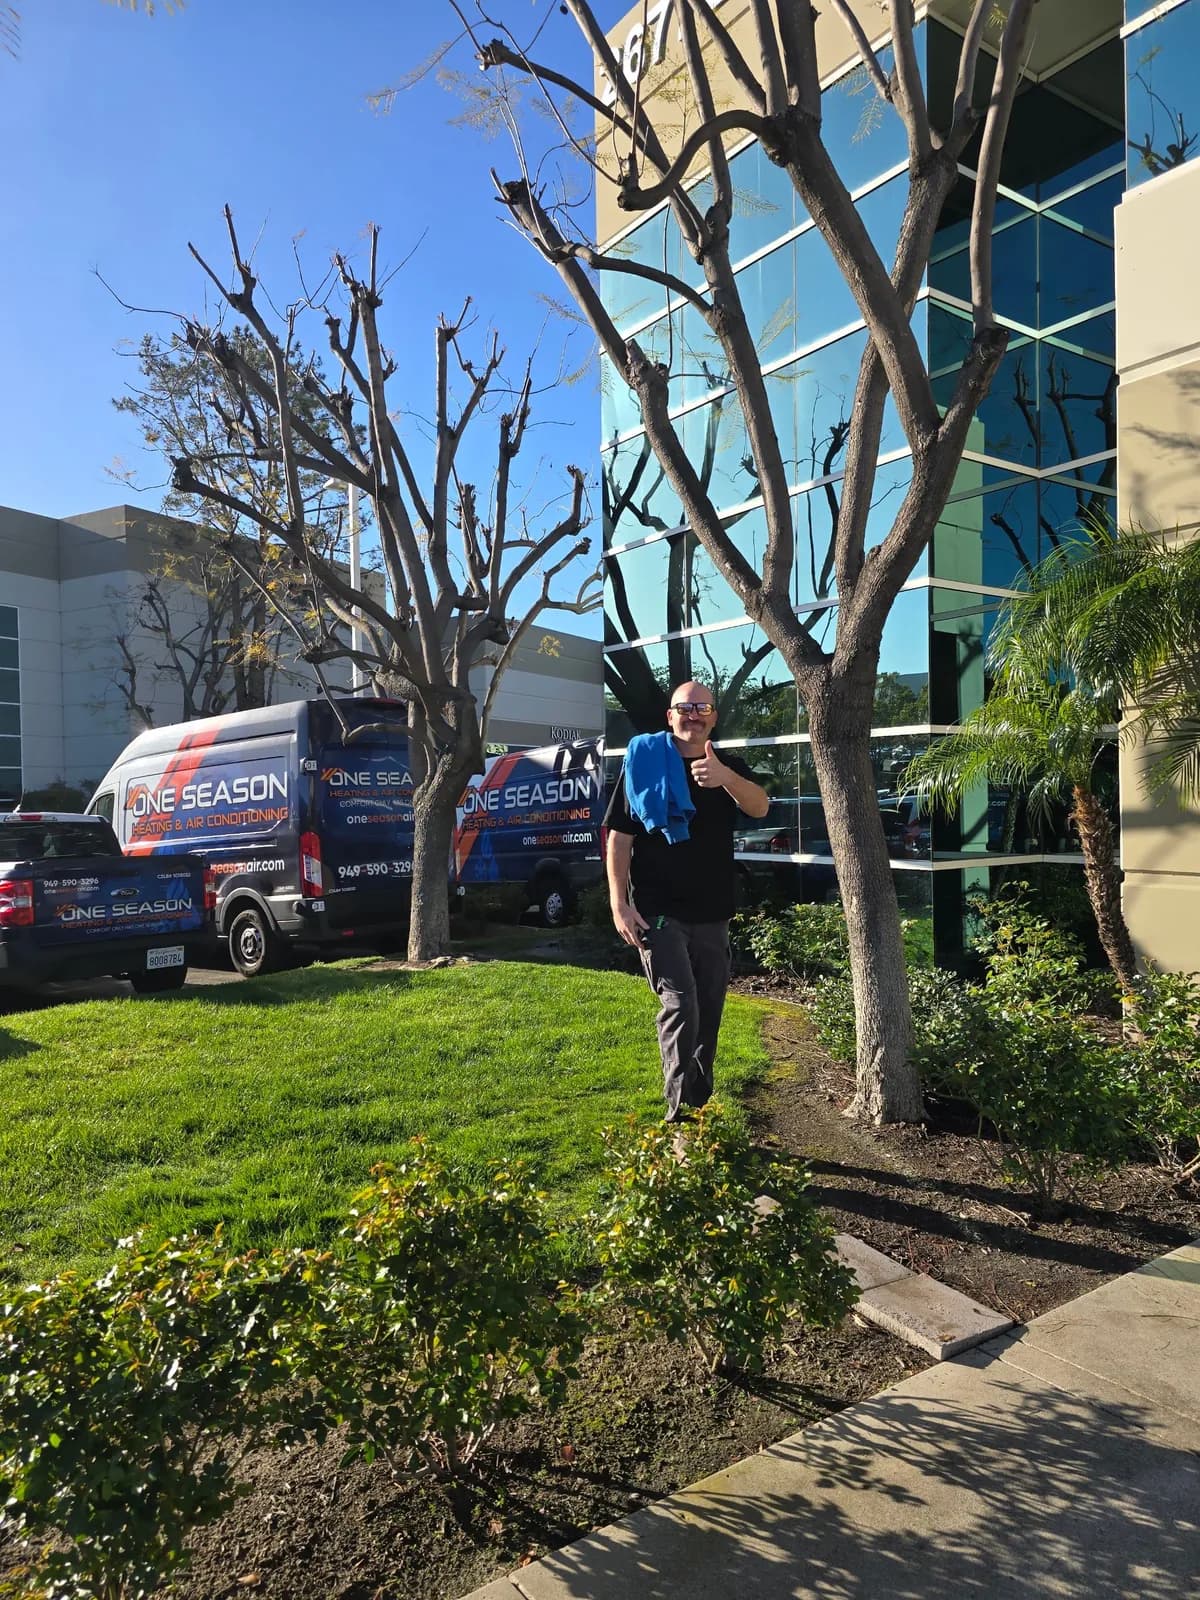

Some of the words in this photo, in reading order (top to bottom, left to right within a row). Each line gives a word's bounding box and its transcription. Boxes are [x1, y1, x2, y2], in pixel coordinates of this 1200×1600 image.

[330, 771, 371, 786] ONE
[375, 771, 415, 786] SEA
[132, 786, 175, 817] ONE
[182, 772, 288, 810] SEASON
[463, 790, 499, 813] ONE
[504, 776, 591, 809] SEASON
[132, 820, 172, 837] HEATING
[175, 819, 182, 830] &
[186, 816, 204, 828] AIR
[207, 807, 289, 827] CONDITIONING
[346, 811, 416, 824] oneseasonair
[463, 818, 497, 830] HEATING
[507, 816, 521, 825] AIR
[523, 807, 590, 823] CONDITIONING
[522, 831, 593, 846] oneseasonair.com
[210, 857, 285, 874] seasonair.com
[338, 861, 415, 878] 949-590-329
[61, 905, 106, 922] ONE
[112, 898, 193, 917] SEASON
